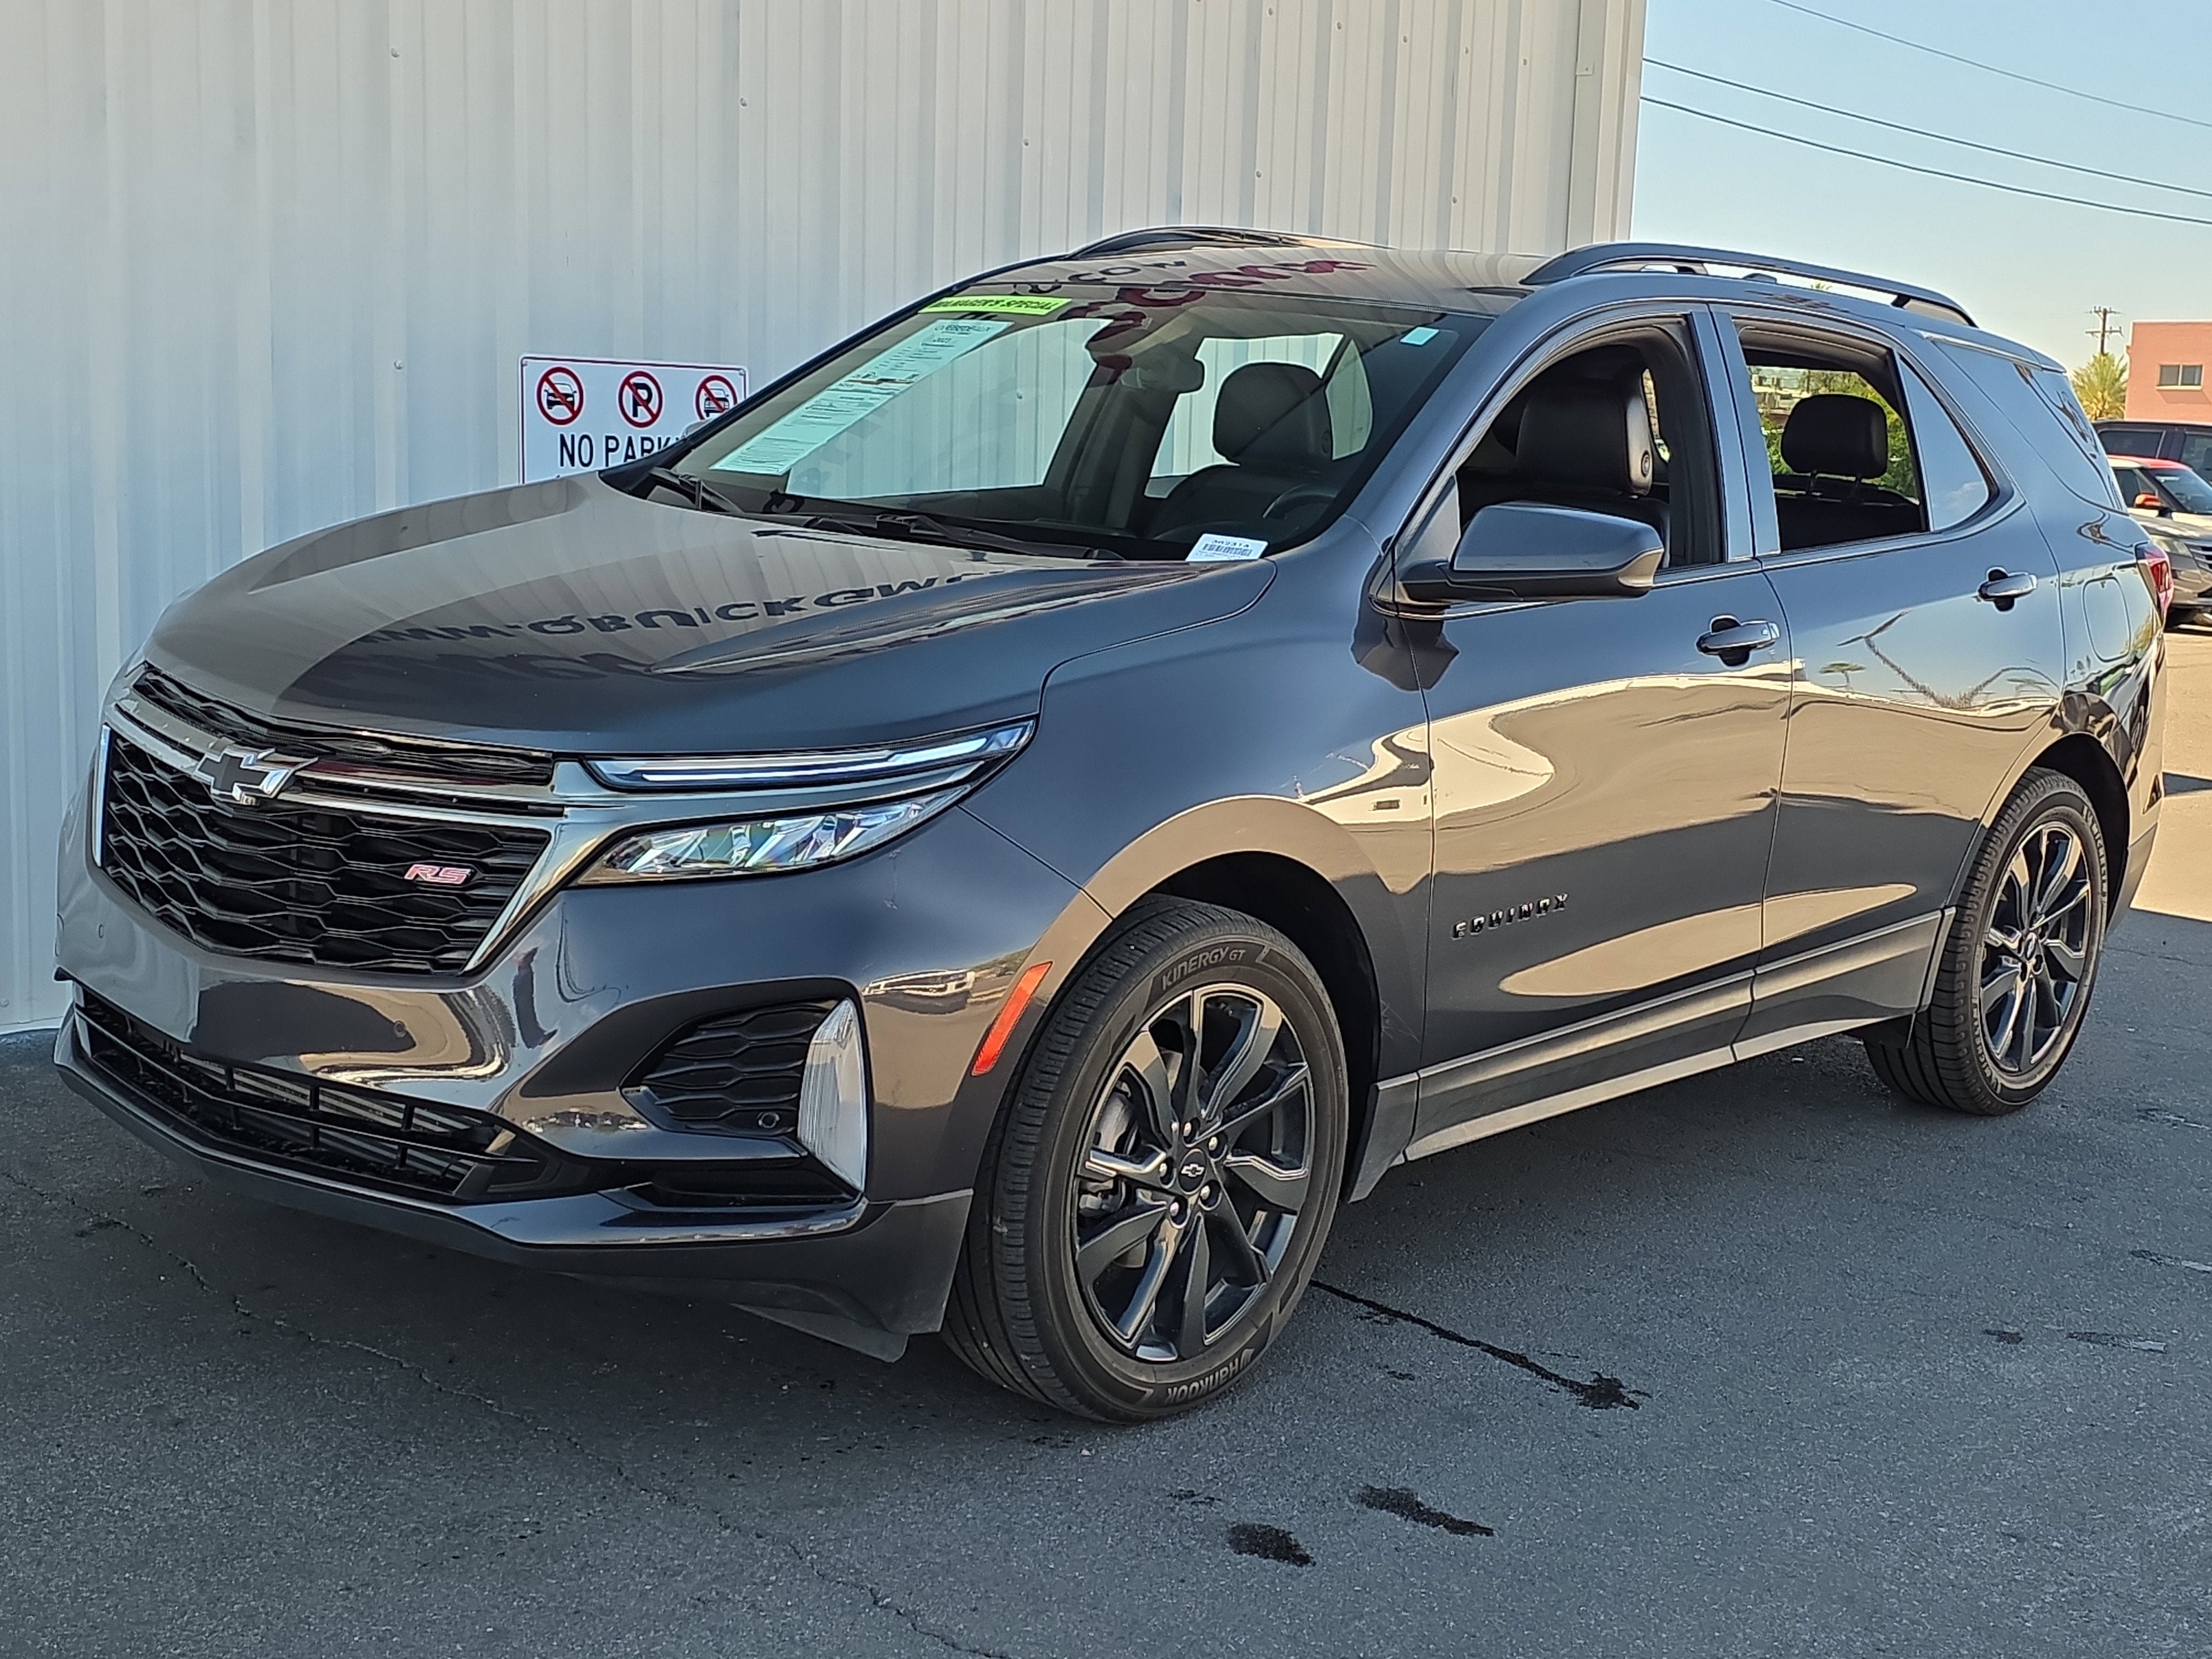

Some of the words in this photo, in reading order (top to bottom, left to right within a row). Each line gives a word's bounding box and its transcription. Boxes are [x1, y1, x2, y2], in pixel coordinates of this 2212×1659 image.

[1001, 299, 1059, 310] SPECIAL
[560, 433, 594, 468] NO
[605, 435, 679, 467] PAR
[404, 864, 471, 884] RS
[1451, 892, 1568, 940] EQUINOX
[1162, 946, 1229, 991] KINERGY
[1229, 949, 1246, 961] GT
